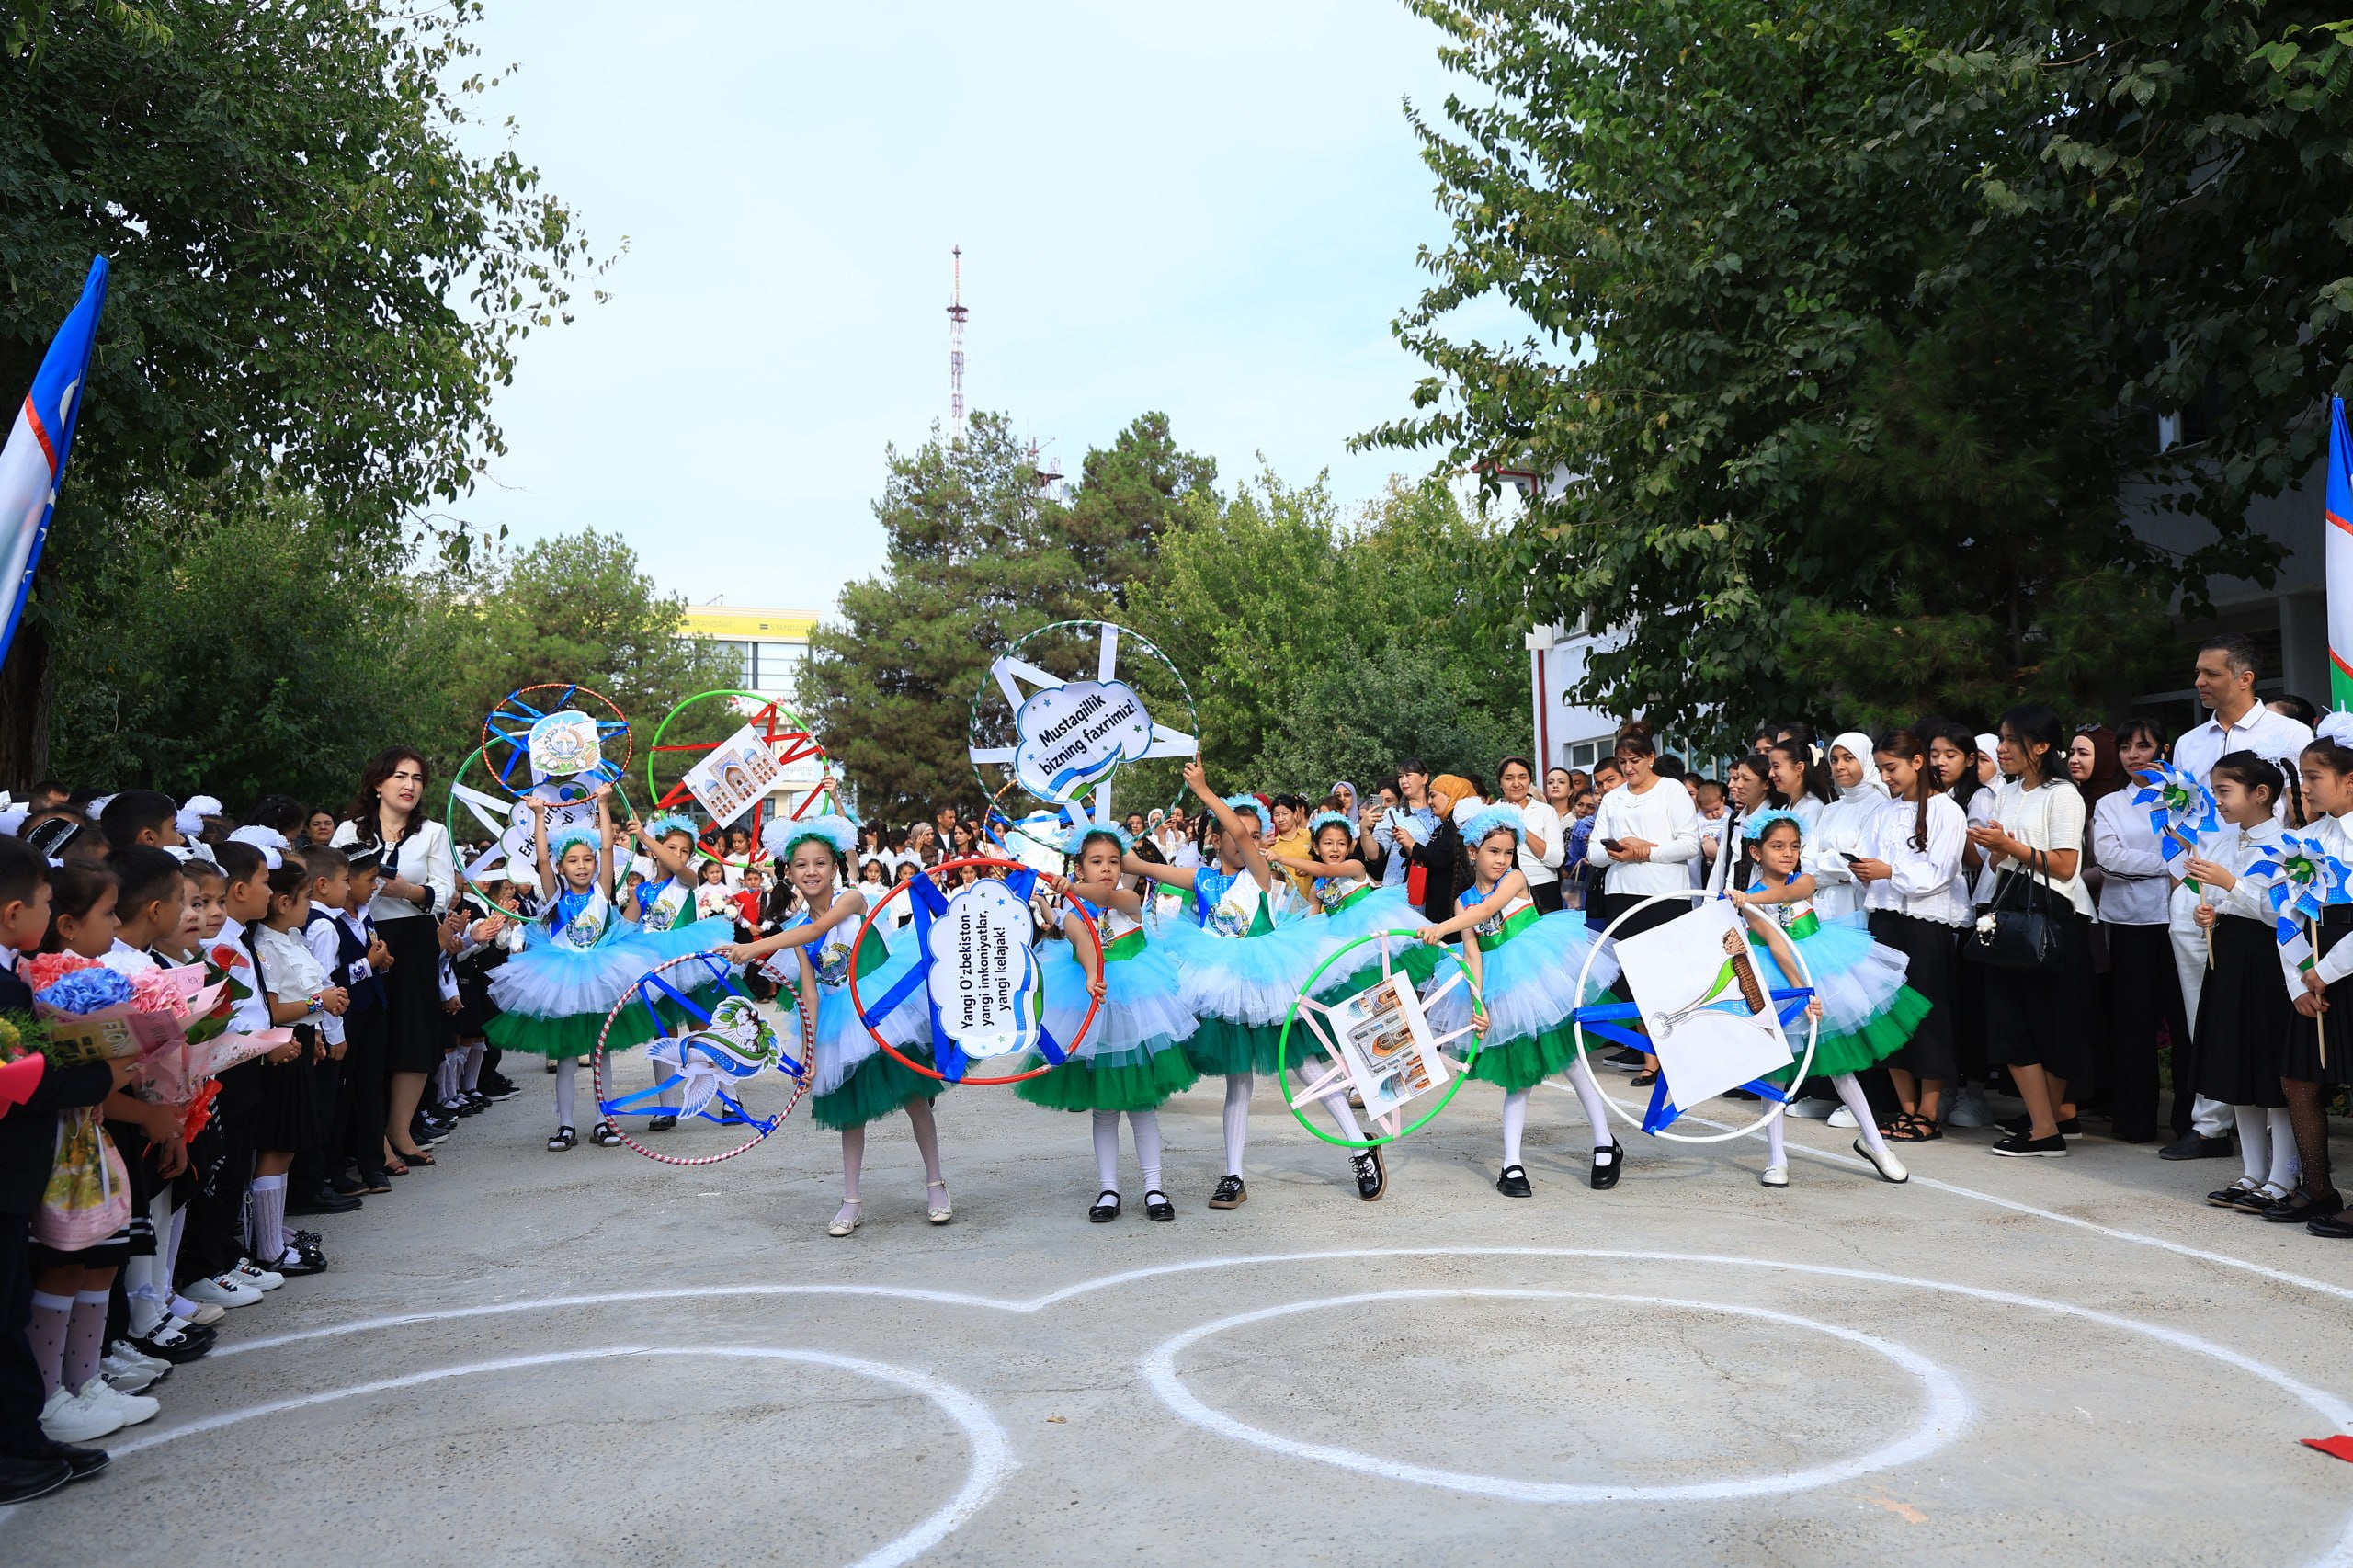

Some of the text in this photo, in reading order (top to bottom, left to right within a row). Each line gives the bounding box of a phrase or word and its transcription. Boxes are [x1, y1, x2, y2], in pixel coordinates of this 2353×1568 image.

[1039, 694, 1106, 747] Mustaqillik
[1039, 699, 1138, 776] bizning faxrimiz!
[976, 910, 995, 1026] yangi imkoniyatlar,
[993, 927, 1012, 1011] yangi kelajak!
[961, 995, 976, 1029] Yangi
